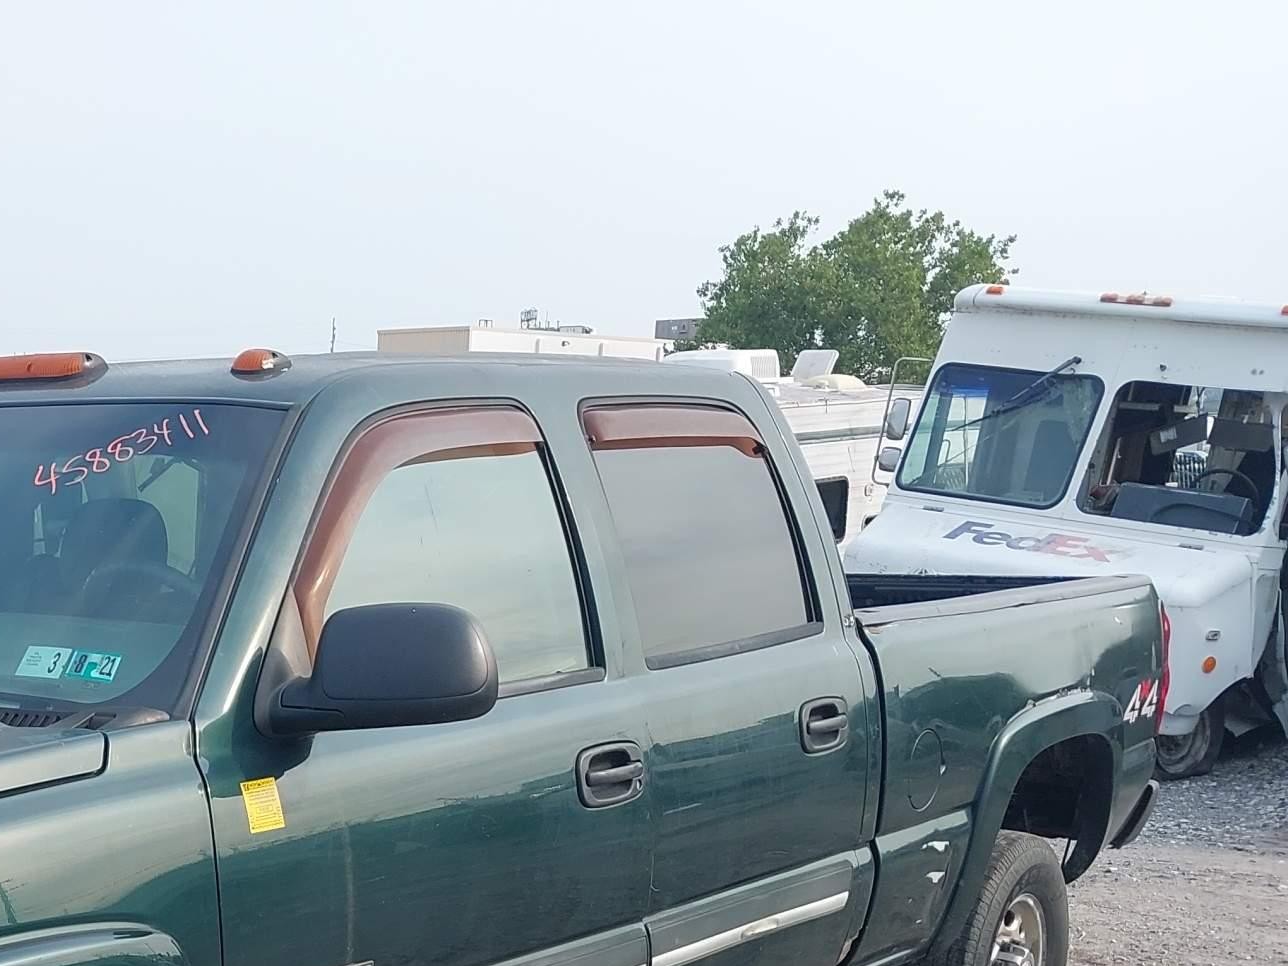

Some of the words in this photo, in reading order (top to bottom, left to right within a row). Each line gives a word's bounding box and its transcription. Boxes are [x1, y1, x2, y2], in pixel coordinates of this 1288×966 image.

[34, 409, 209, 495] 45883411
[943, 520, 1111, 563] FedEx
[47, 652, 61, 673] 3
